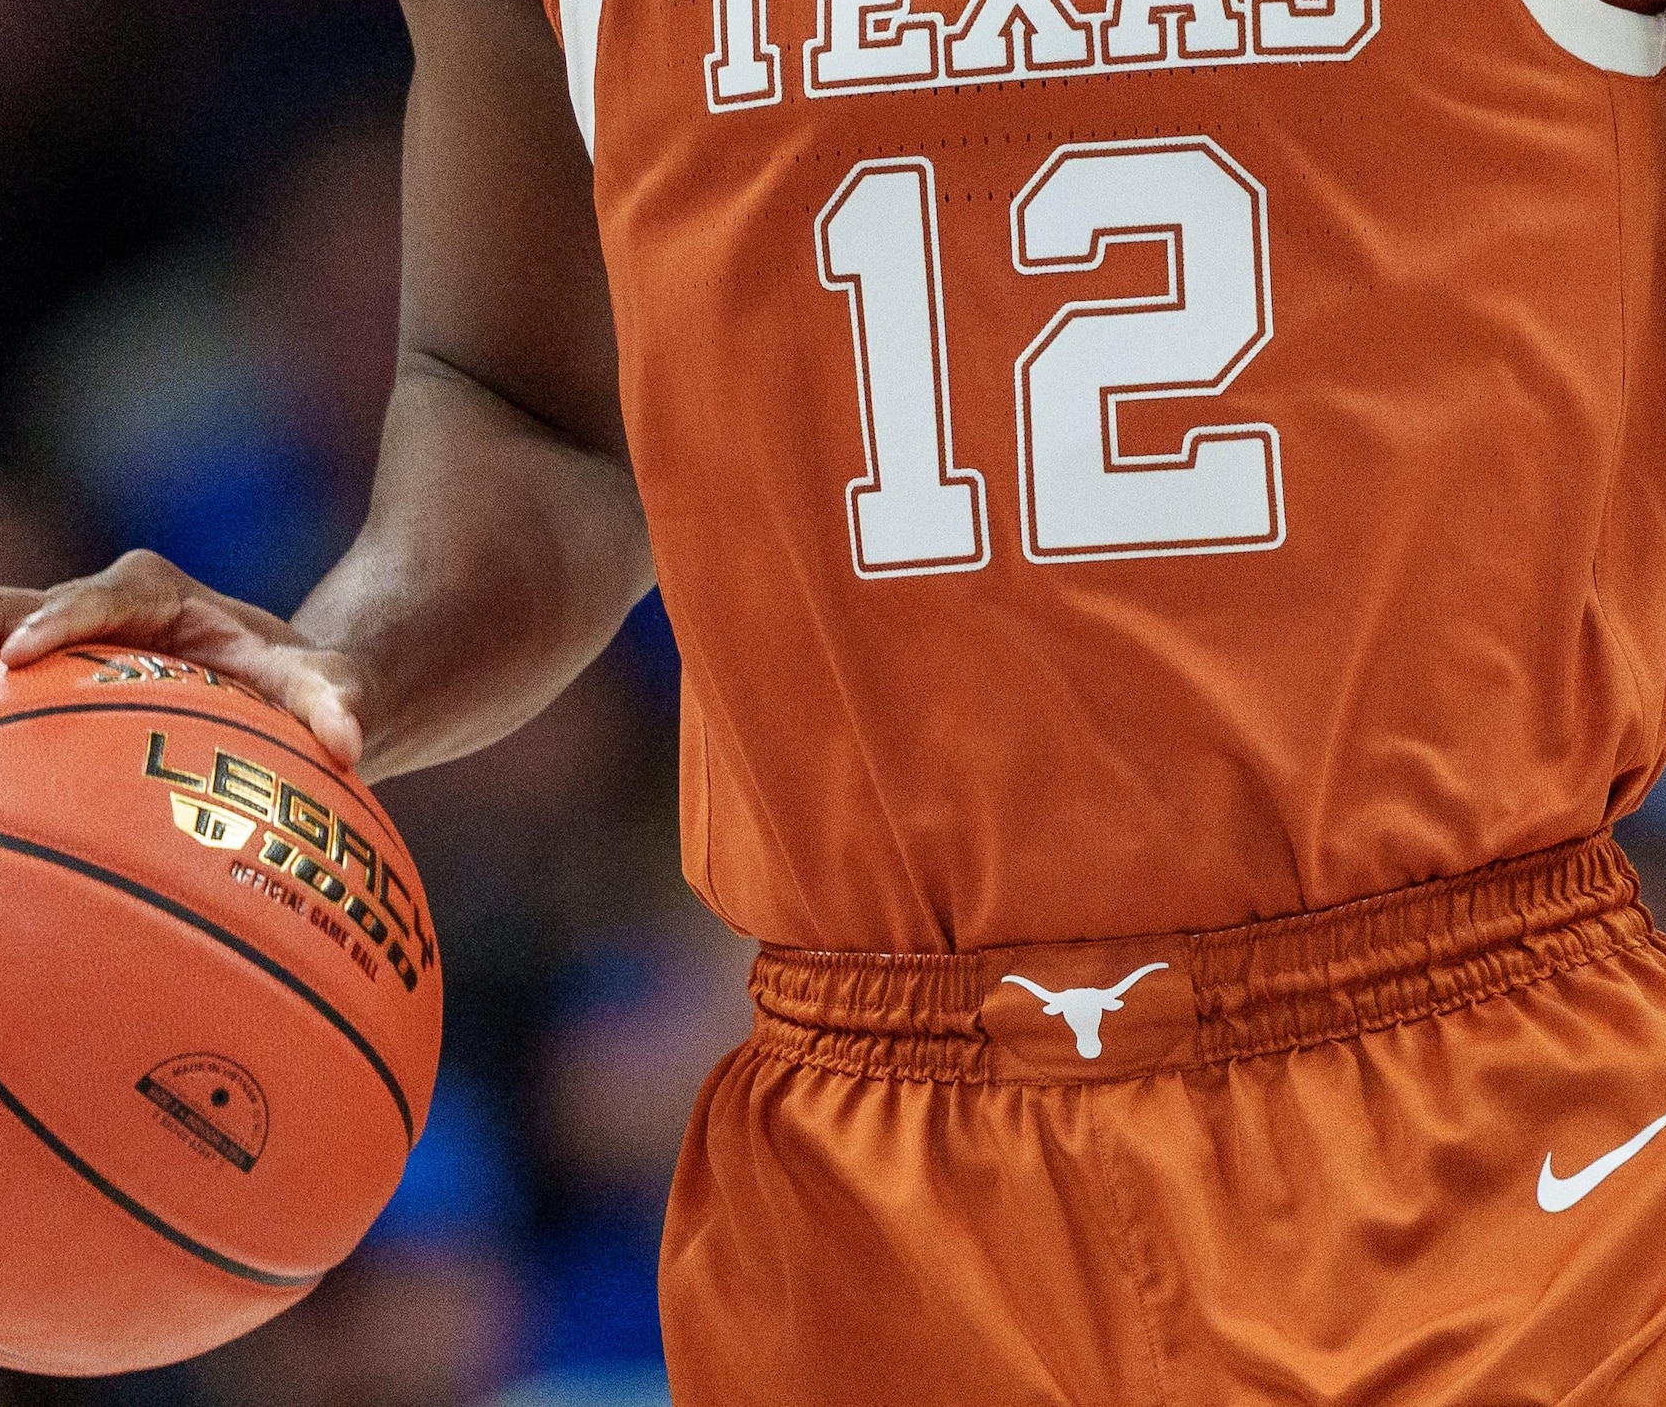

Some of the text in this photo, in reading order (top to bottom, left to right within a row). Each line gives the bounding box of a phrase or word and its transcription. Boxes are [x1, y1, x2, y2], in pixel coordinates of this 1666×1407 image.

[813, 135, 1286, 580] 12
[143, 730, 434, 971] LEGACY
[230, 859, 380, 984] OFFICIAL GAME BALL
